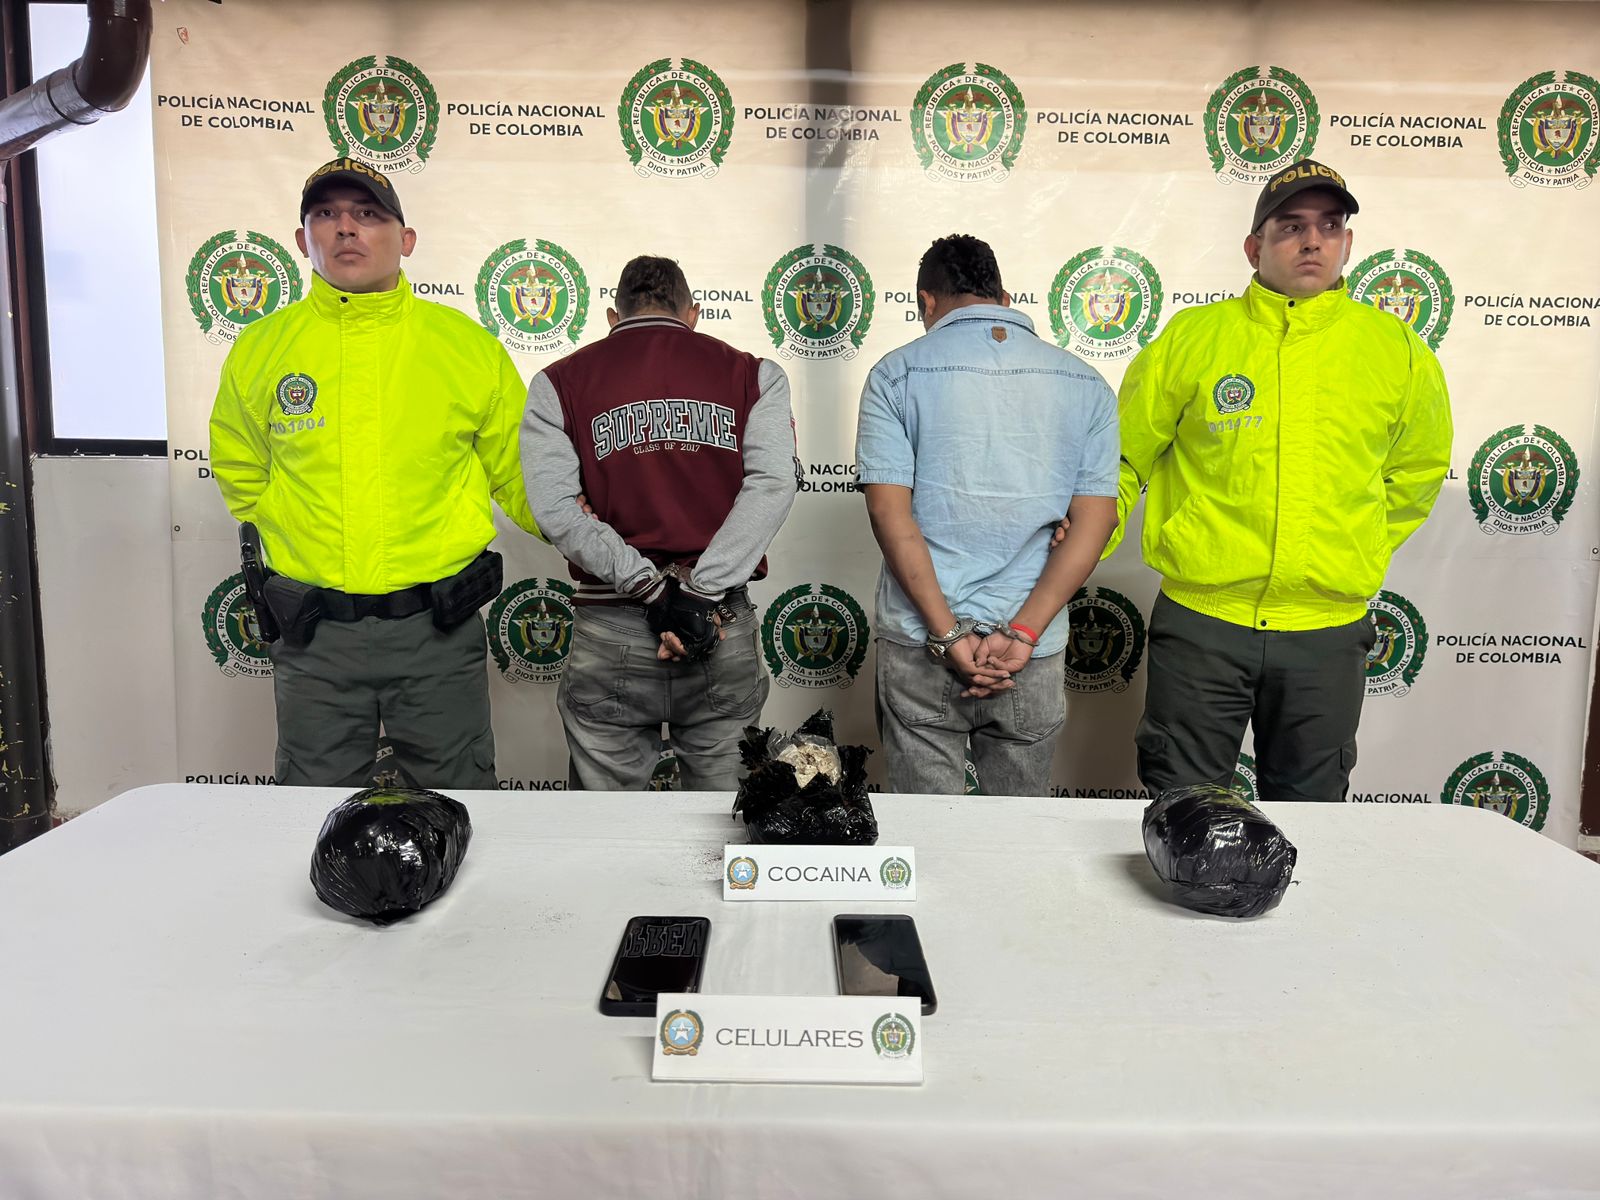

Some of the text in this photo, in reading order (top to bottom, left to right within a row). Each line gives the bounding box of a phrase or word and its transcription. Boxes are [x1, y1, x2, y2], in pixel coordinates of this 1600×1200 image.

[158, 94, 315, 113] POLICÍA NACIONAL
[397, 73, 425, 121] COLOMBIA
[694, 78, 720, 125] COLOMBIA
[448, 101, 605, 117] POLICÍA NACIONAL
[987, 82, 1012, 129] COLOMBIA
[1281, 85, 1305, 133] COLOMBIA
[1577, 89, 1600, 135] COLOMBIA
[182, 115, 294, 132] DE COLOMBIA
[745, 108, 902, 123] POLICÍA NACIONAL
[1037, 109, 1193, 125] POLICÍA NACIONAL
[1331, 113, 1486, 129] POLICÍA NACIONAL
[470, 123, 583, 136] DE COLOMBIA
[767, 127, 879, 142] DE COLOMBIA
[1058, 131, 1170, 144] DE COLOMBIA
[383, 131, 422, 159] NACIONAL
[1351, 135, 1463, 147] DE COLOMBIA
[677, 136, 717, 164] NACIONAL
[968, 140, 1008, 168] NACIONAL
[1259, 143, 1300, 171] NACIONAL
[384, 158, 413, 171] PATRIA
[1555, 146, 1597, 174] NACIONAL
[648, 161, 667, 174] DIOS
[677, 162, 706, 176] PATRIA
[938, 165, 957, 178] DIOS
[967, 166, 997, 180] PATRIA
[1230, 168, 1248, 181] DIOS
[1524, 171, 1543, 184] DIOS
[1554, 172, 1585, 185] PATRIA
[260, 249, 288, 296] COLOMBIA
[548, 257, 576, 304] COLOMBIA
[413, 283, 464, 296] IONAL
[835, 263, 861, 309] COLOMBIA
[1125, 264, 1149, 310] COLOMBIA
[1415, 267, 1439, 313] COLOMBIA
[692, 289, 753, 302] CIONAL
[1465, 294, 1600, 308] POLICÍA NACIONA
[534, 314, 573, 341] NACIONAL
[1485, 314, 1590, 327] DE COLOMBIA
[818, 319, 857, 346] NACIONAL
[505, 337, 524, 351] DIOS
[535, 339, 563, 352] PATRIA
[789, 343, 808, 356] DIOS
[818, 345, 847, 358] PATRIA
[591, 399, 739, 461] SUPREME
[633, 442, 701, 455] CLASS OF 2017
[1543, 442, 1564, 486] COLOMBIA
[1521, 496, 1559, 522] NACIONAL
[1493, 519, 1510, 531] DIOS
[1520, 520, 1548, 532] PATRIA
[832, 600, 856, 642] COLOMBIA
[1390, 607, 1413, 649] COLOMBIA
[1437, 633, 1586, 648] POLICÍA NACIONAL
[1456, 652, 1561, 663] DE COLOMBIA
[1369, 659, 1409, 684] NACIONAL
[1369, 682, 1398, 694] PATRIA
[185, 771, 250, 784] POLICÍA
[1513, 768, 1536, 809] COLOMBIA
[1352, 793, 1431, 804] NACIONAL
[767, 866, 871, 882] COCAINA
[716, 1027, 864, 1048] CELULARES
